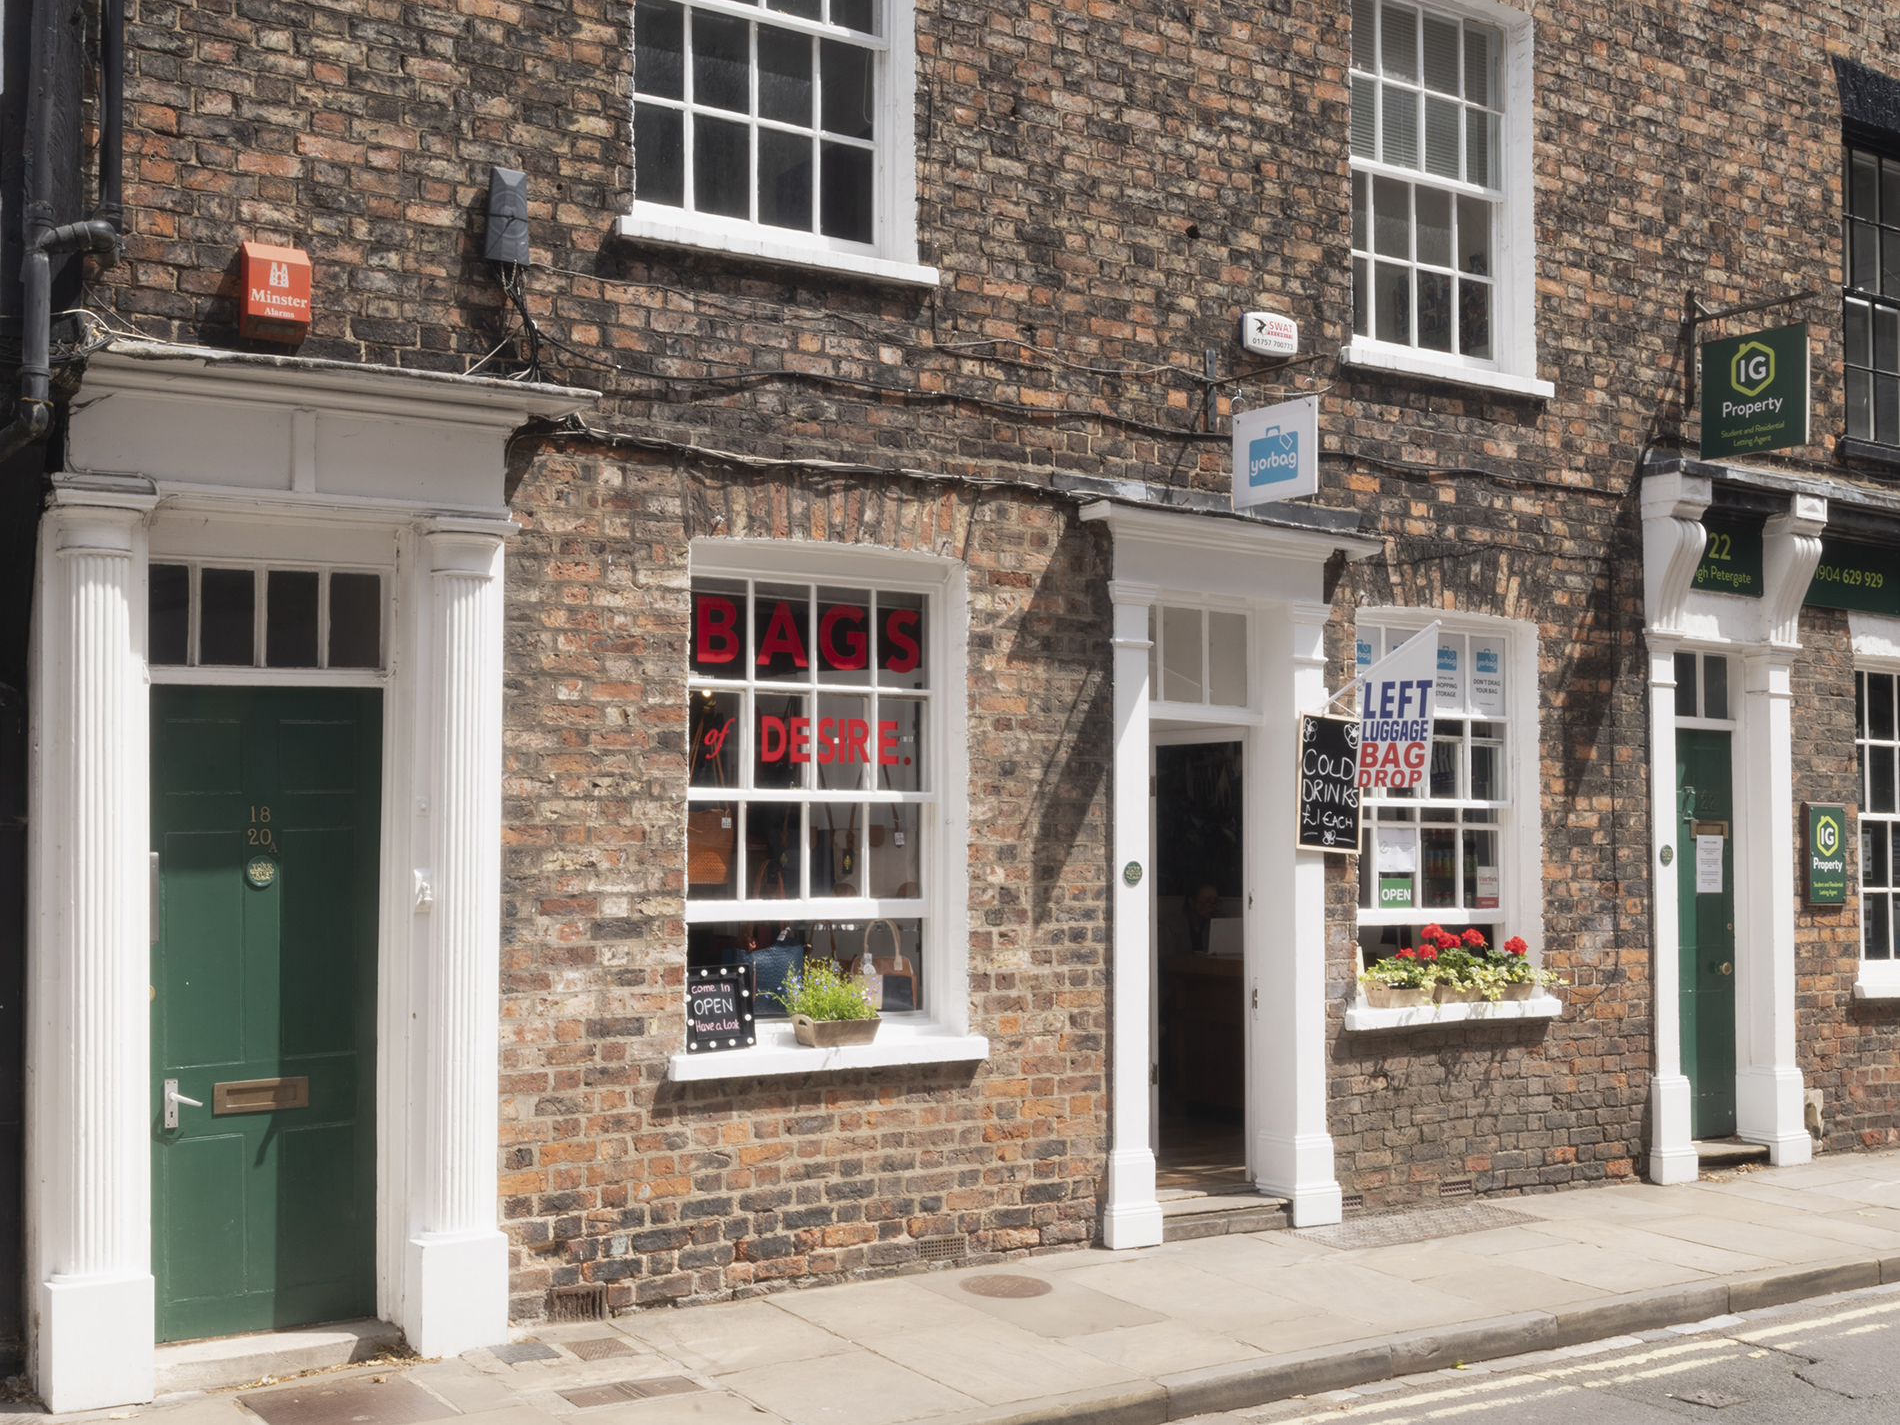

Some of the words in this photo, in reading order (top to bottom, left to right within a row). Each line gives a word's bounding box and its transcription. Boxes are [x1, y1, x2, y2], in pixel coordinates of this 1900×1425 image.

[250, 288, 308, 308] Minster
[264, 307, 295, 318] Alarms
[1269, 321, 1293, 333] SWAT
[1252, 337, 1272, 346] 01757
[1740, 356, 1767, 383] IG
[1722, 397, 1783, 418] Property
[1721, 429, 1743, 438] Student
[1743, 425, 1754, 435] and
[1755, 420, 1785, 432] Residential
[1733, 437, 1753, 447] Letting
[1753, 435, 1771, 445] Agent
[1250, 451, 1297, 477] yorbag
[1708, 532, 1731, 561] 22
[1695, 564, 1709, 583] igh
[1710, 565, 1752, 587] Petergate
[1815, 564, 1840, 582] 1904
[1842, 568, 1862, 585] 629
[1864, 571, 1884, 588] 929
[696, 596, 920, 673] BAGS
[1477, 659, 1497, 669] yorbag
[1363, 679, 1433, 719] LEFT
[1435, 690, 1456, 698] STORAGE
[703, 717, 736, 759] of
[761, 715, 912, 766] DESIRE.
[1361, 720, 1429, 742] LUGGAGE
[1302, 748, 1355, 780] COLD
[1359, 741, 1426, 769] BAG
[1357, 769, 1423, 788] DROP
[1302, 778, 1359, 808] DRINKS
[250, 805, 271, 823] 18
[1820, 827, 1835, 846] IG
[1813, 857, 1843, 873] Property
[1381, 888, 1412, 901] OPEN
[693, 997, 734, 1015] OPEN
[695, 1019, 715, 1033] Have
[715, 1023, 723, 1031] a
